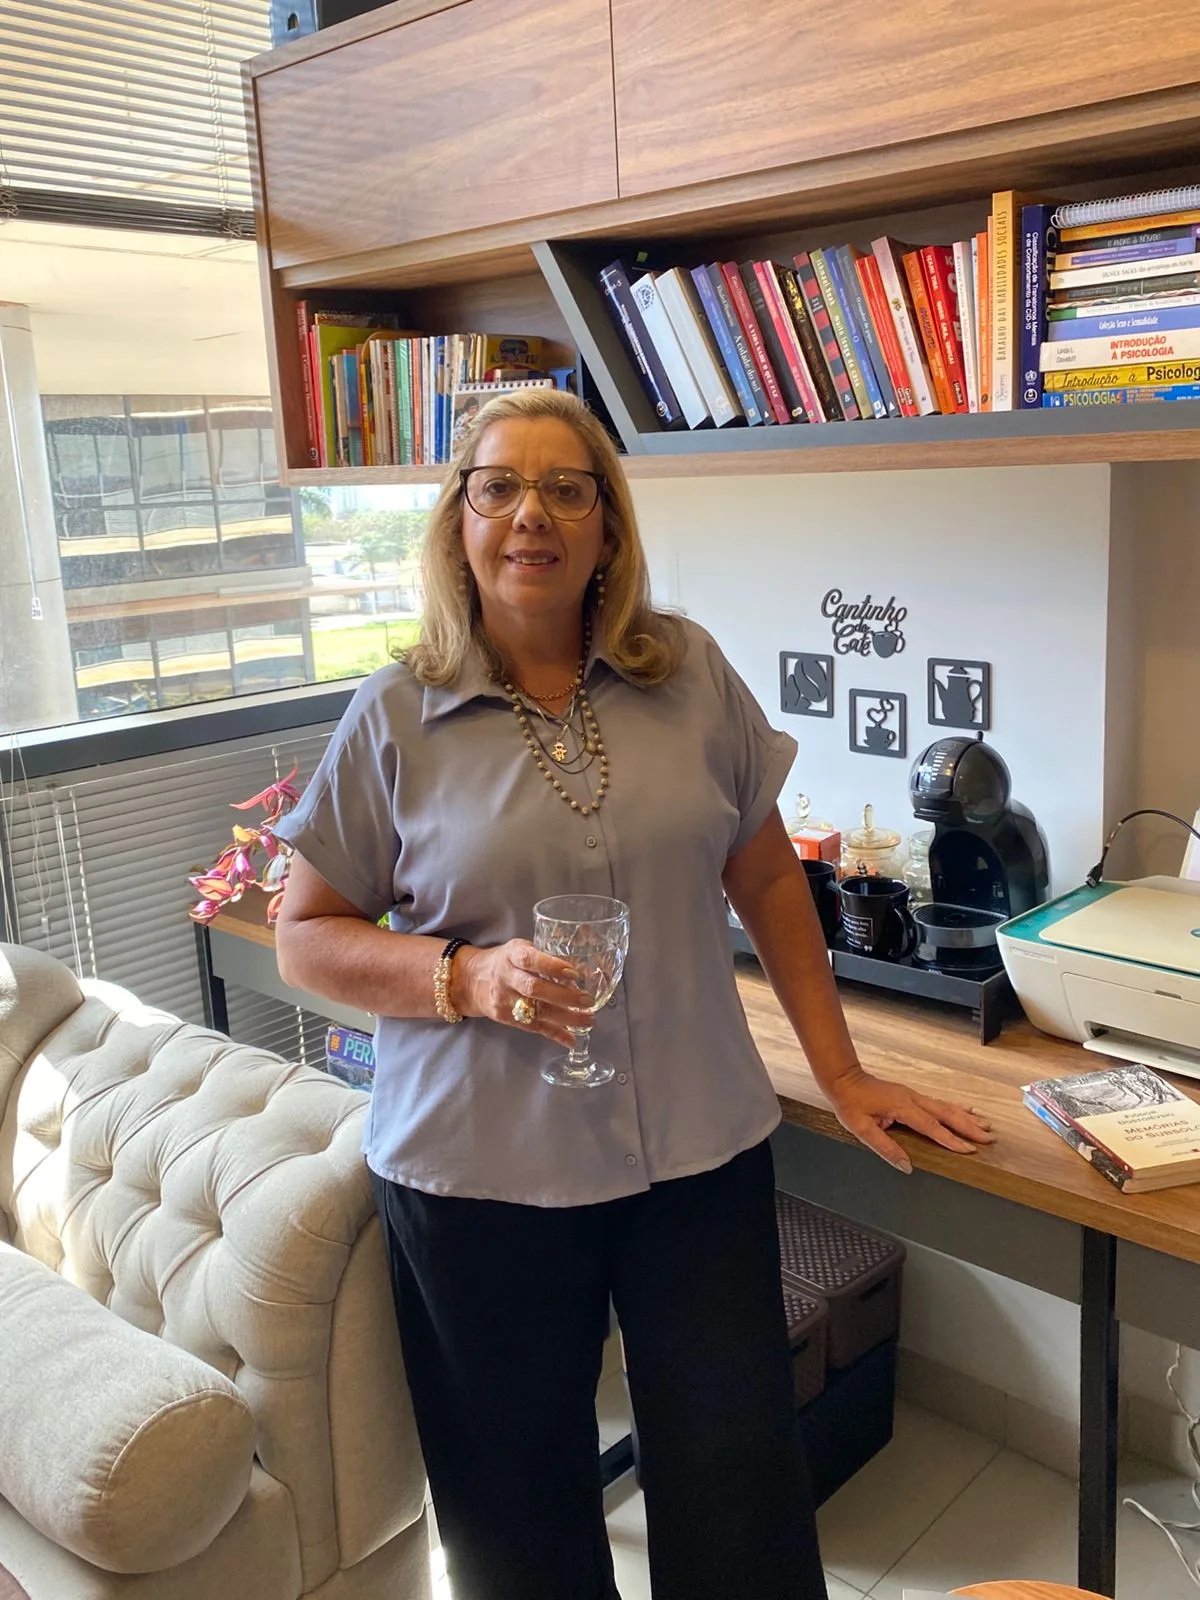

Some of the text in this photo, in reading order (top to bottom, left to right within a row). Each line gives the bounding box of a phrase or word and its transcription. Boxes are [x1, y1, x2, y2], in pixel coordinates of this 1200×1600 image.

[935, 300, 946, 320] QUEM
[1110, 335, 1167, 350] INTRODUÇÃO
[736, 340, 752, 370] cidade
[1121, 346, 1174, 359] PSICOLOGIA
[745, 367, 756, 380] do
[1062, 371, 1119, 388] Introdução
[1128, 371, 1137, 382] à
[750, 378, 761, 392] sol
[821, 588, 907, 623] Cantinho
